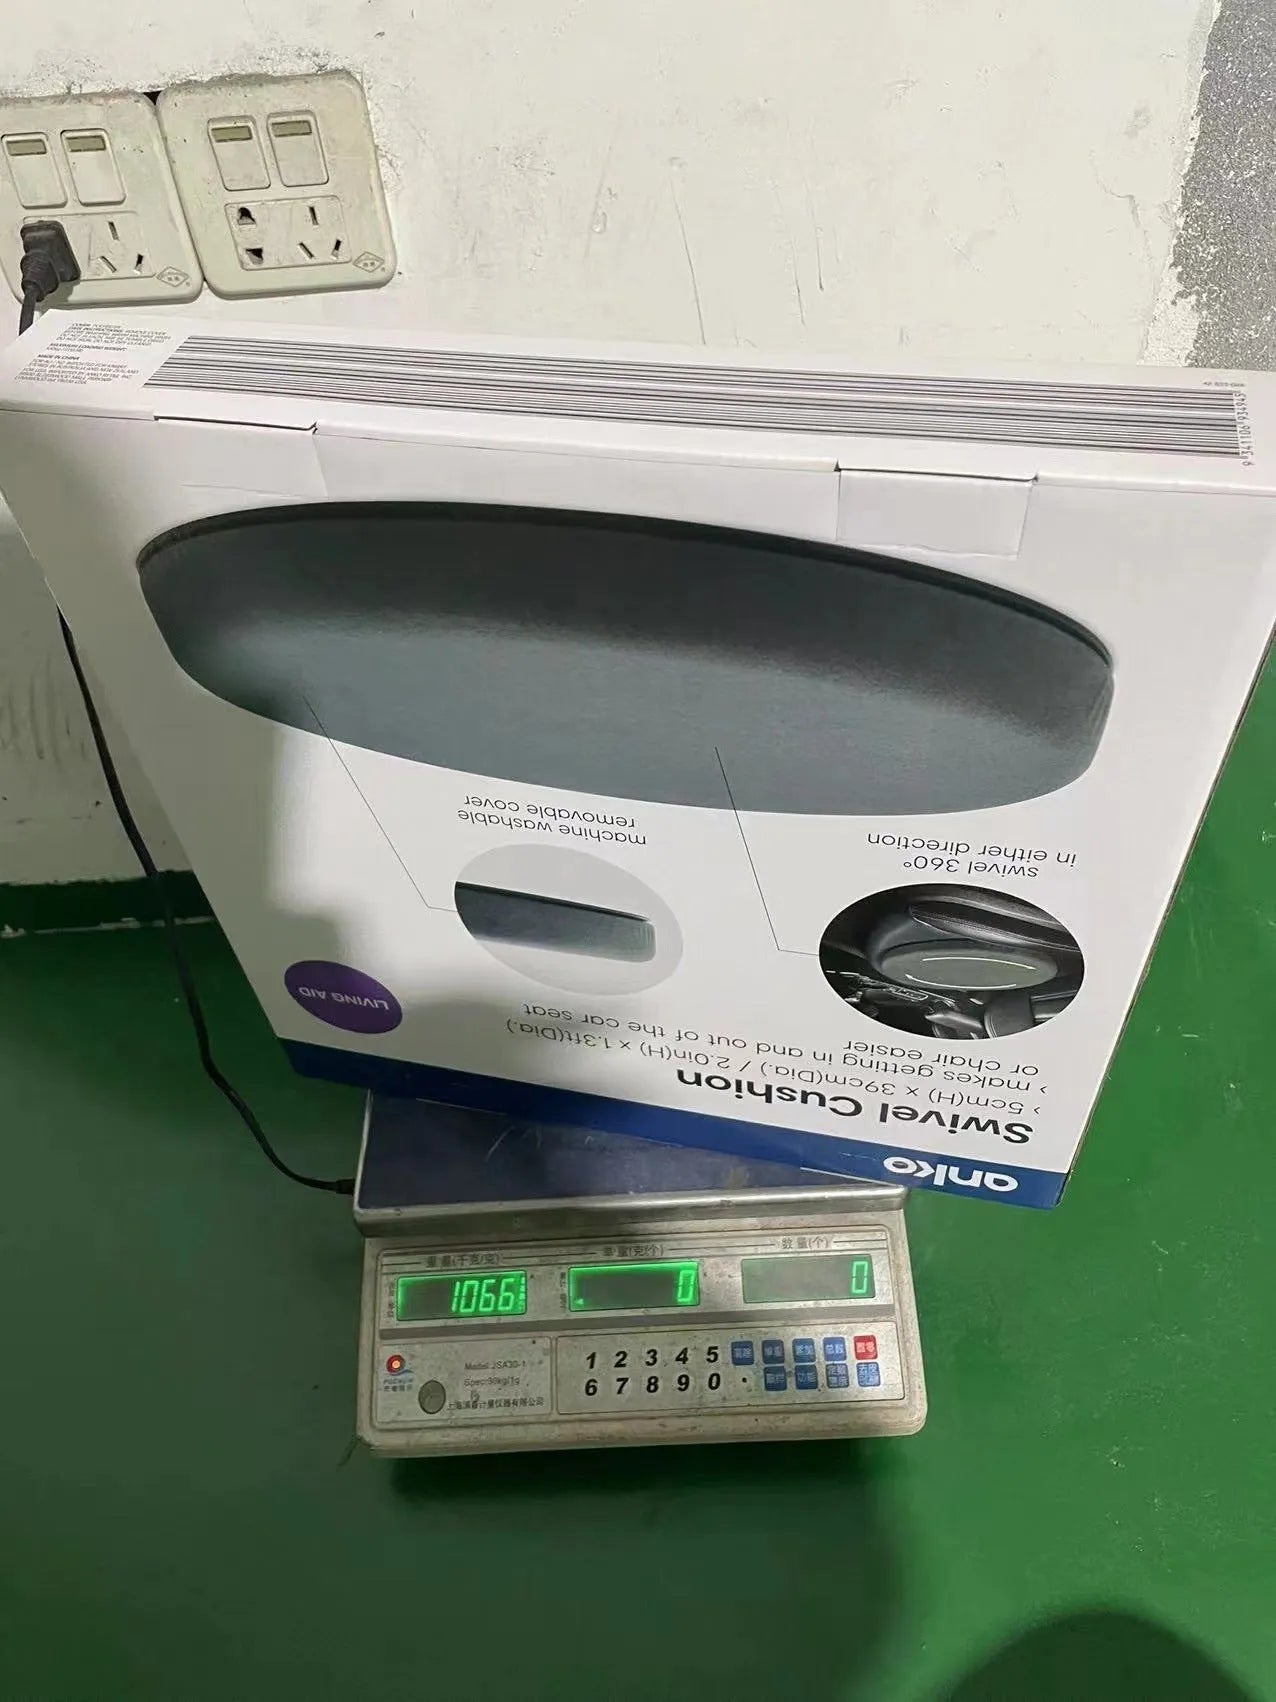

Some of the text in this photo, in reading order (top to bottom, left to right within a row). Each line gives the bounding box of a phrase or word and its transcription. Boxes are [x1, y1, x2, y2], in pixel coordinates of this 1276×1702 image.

[458, 809, 647, 845] machine washable
[464, 795, 636, 828] removable cover
[867, 833, 1077, 867] in either direction
[903, 855, 1039, 877] swivel 360°
[298, 986, 390, 1010] LIVING AID
[523, 1003, 1030, 1091] makes getting in and out of the car seat
[843, 1040, 1039, 1076] or chair easier
[506, 1018, 1025, 1115] 5cm(H) x 39cm(Dia.) / 2.0in(H) x 1.3ft(Dia.)
[676, 1068, 1034, 1145] Swivel Cushion
[883, 1155, 1019, 1193] anko
[676, 1268, 696, 1303] 0
[851, 1260, 869, 1294] 0
[451, 1278, 515, 1313] 1066
[586, 1352, 597, 1370] 1
[614, 1350, 628, 1368] 2
[645, 1348, 658, 1367] 3
[675, 1347, 689, 1365] 4
[706, 1346, 719, 1363] 5
[585, 1372, 721, 1396] 6 7 8 9 0
